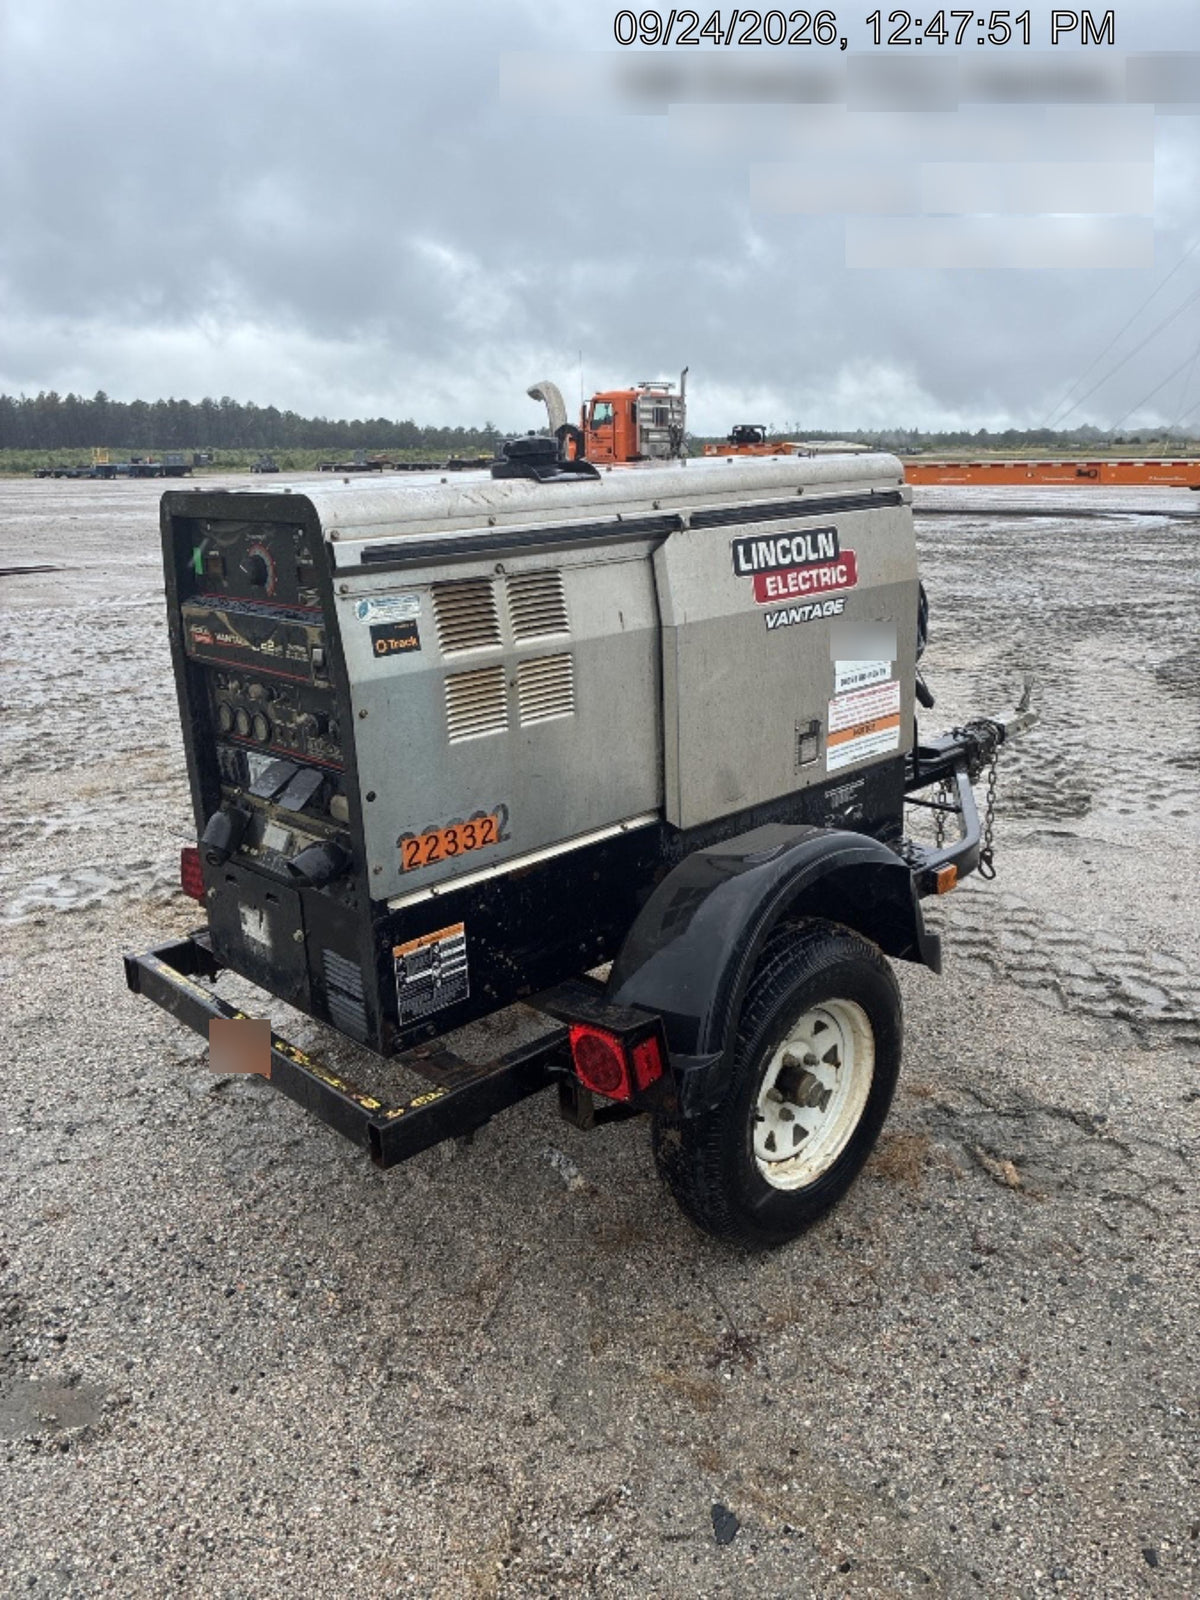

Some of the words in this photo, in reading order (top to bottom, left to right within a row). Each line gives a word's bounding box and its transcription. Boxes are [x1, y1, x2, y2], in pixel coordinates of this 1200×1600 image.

[737, 532, 835, 571] LINCOLN
[766, 564, 848, 597] ELECTRIC
[765, 599, 845, 630] VANTAGE
[405, 818, 495, 868] 22332
